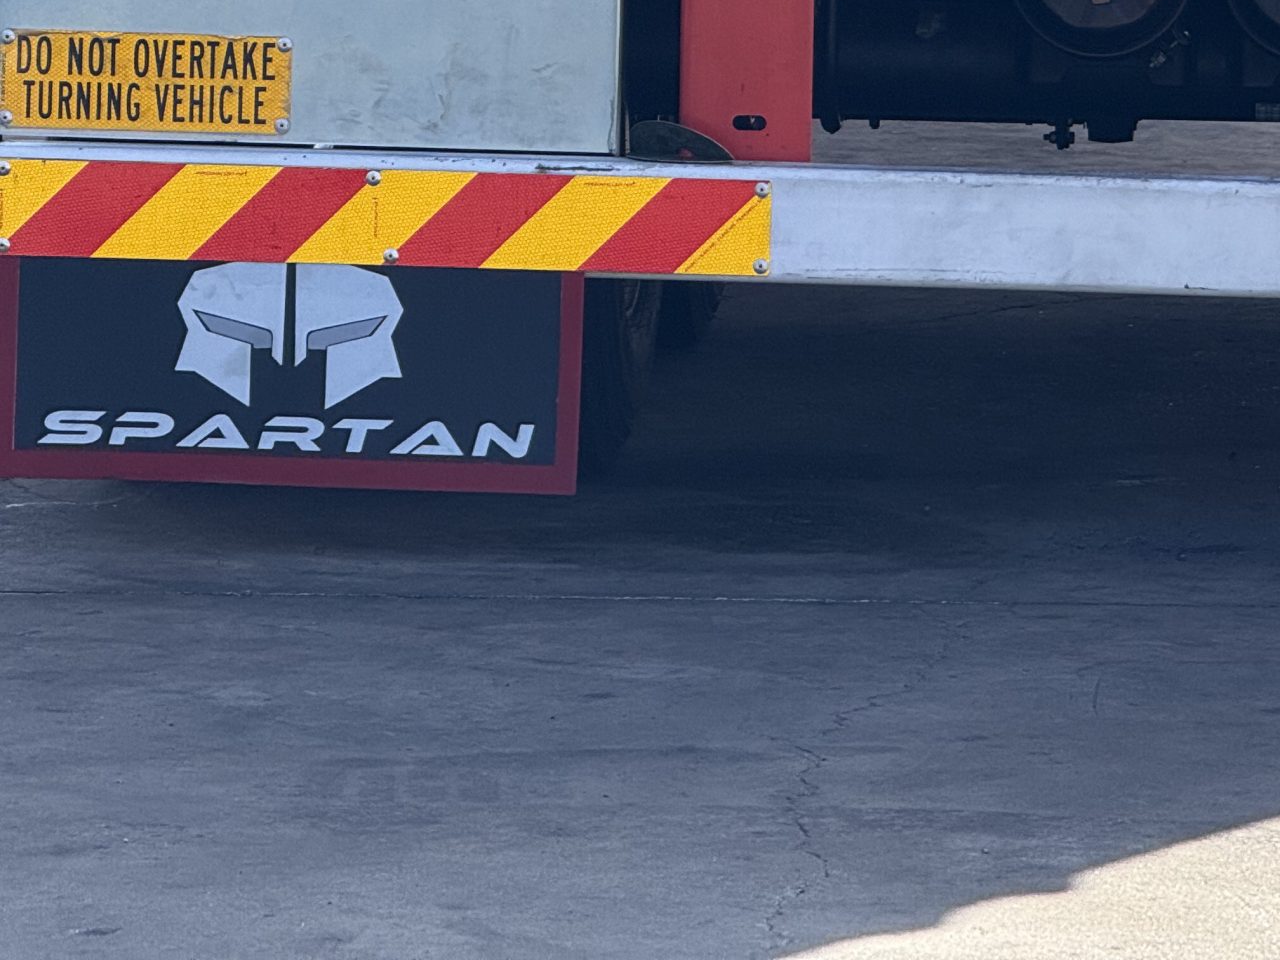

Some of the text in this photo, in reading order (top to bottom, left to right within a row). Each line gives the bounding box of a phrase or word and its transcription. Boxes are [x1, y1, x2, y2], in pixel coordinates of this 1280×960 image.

[16, 35, 53, 75] DO
[67, 37, 120, 77] NOT
[133, 38, 276, 81] OVERTAKE
[23, 80, 267, 125] TURNING VEHICLE
[37, 409, 535, 458] SPARTAN
